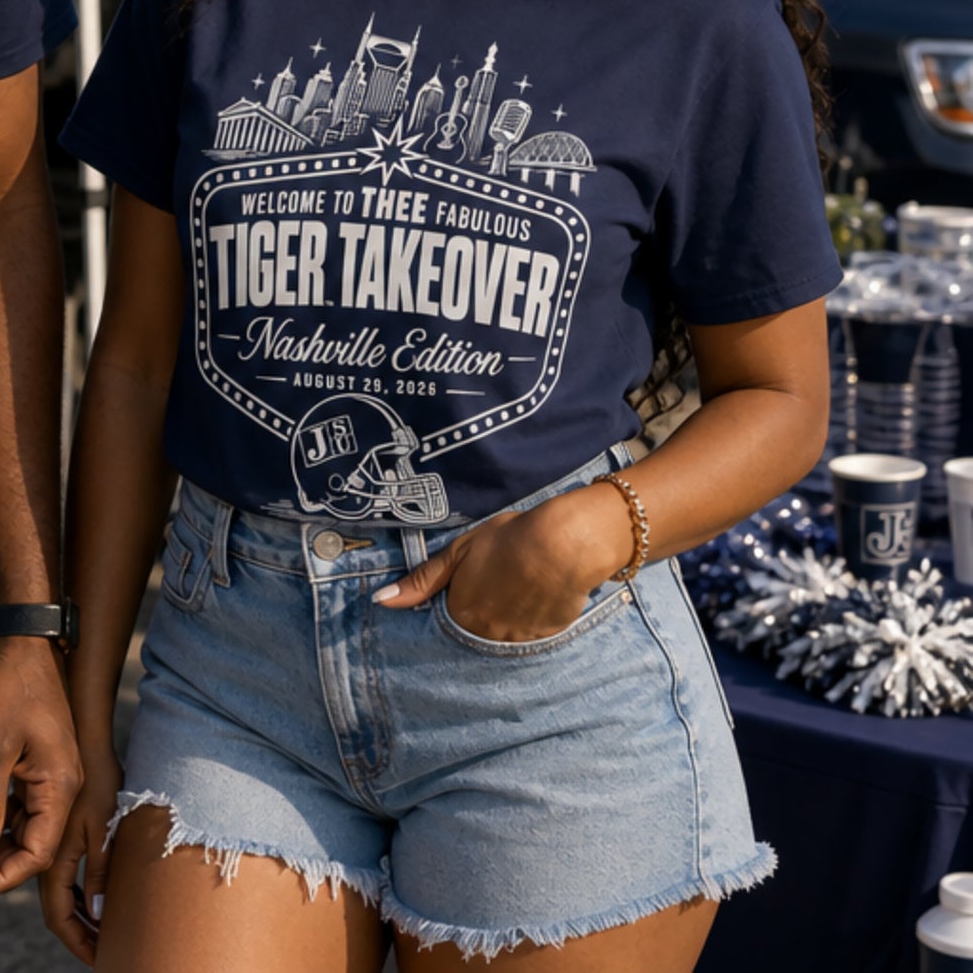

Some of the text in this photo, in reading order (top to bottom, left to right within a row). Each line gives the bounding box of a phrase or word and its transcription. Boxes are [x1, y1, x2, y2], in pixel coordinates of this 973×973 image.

[241, 186, 532, 241] WELCOME TO THEE FABULOUS
[209, 220, 560, 338] TIGER TAKEOVER
[237, 316, 506, 377] Nashville Edition
[292, 372, 356, 391] AUGUST
